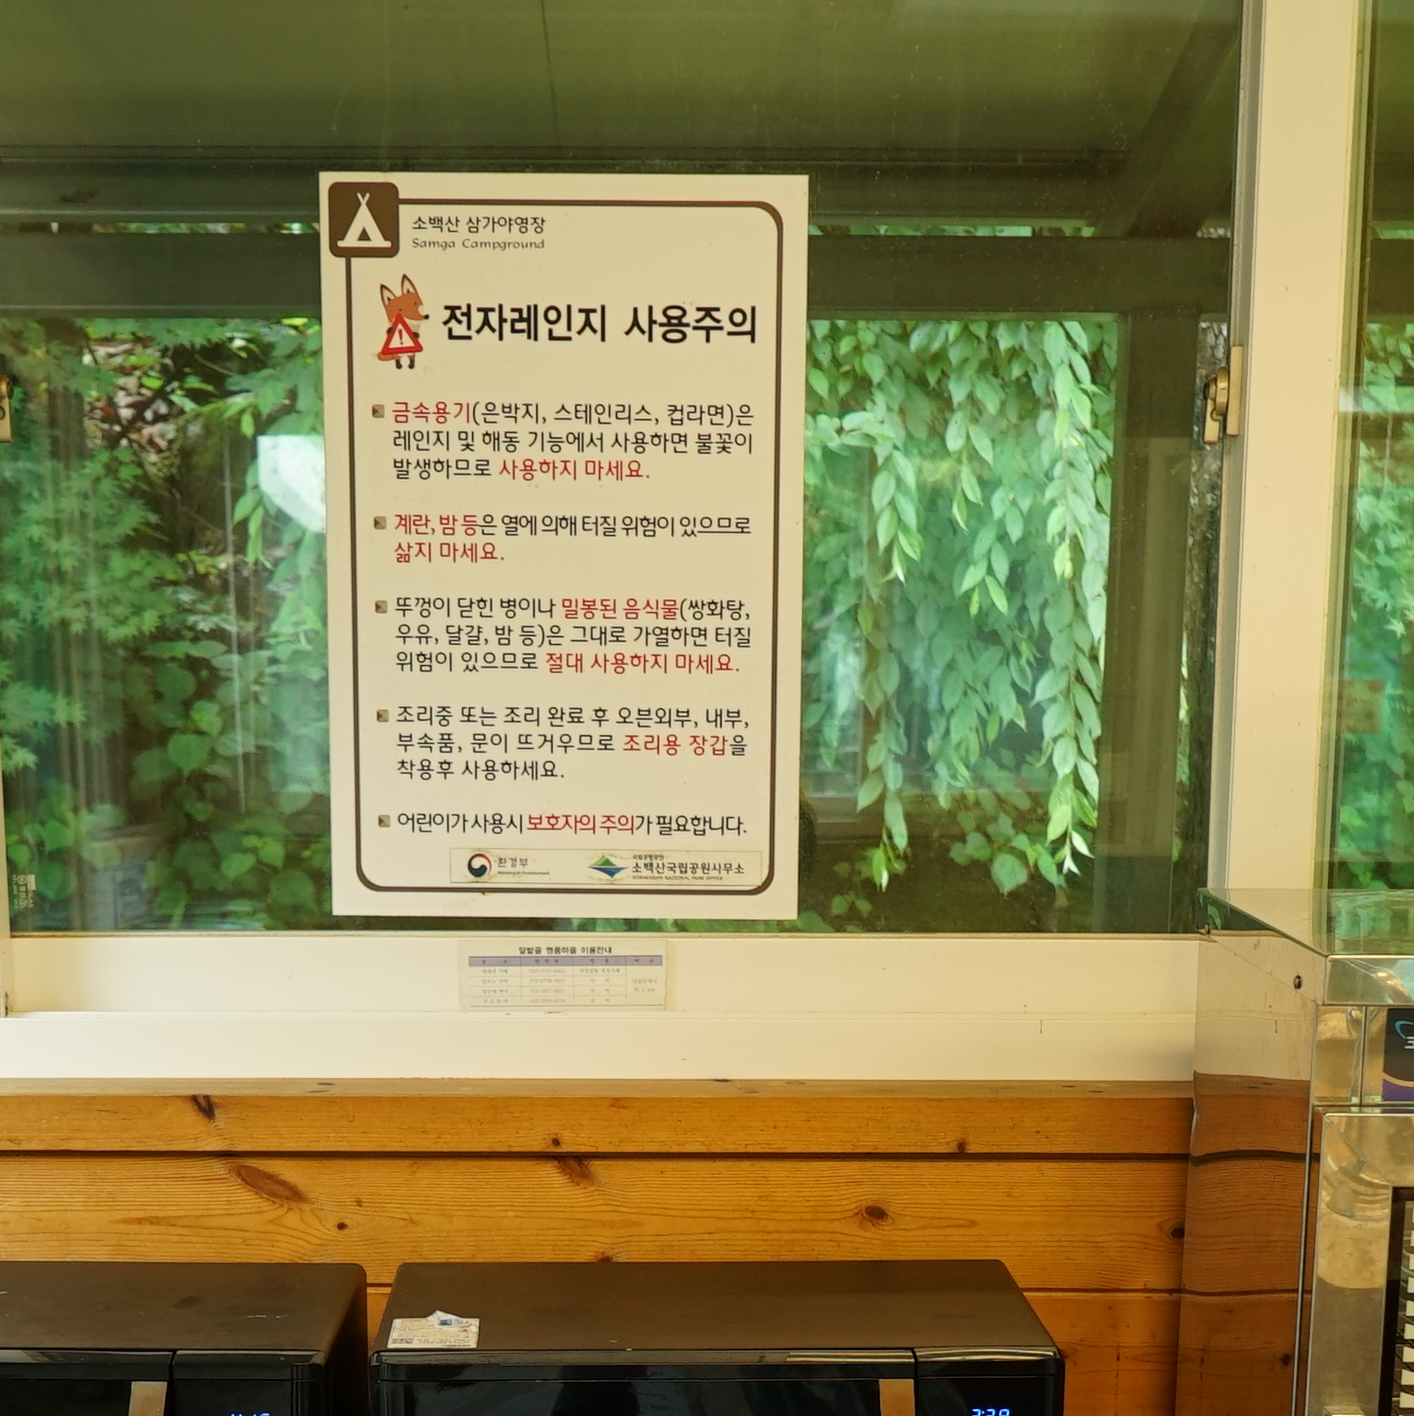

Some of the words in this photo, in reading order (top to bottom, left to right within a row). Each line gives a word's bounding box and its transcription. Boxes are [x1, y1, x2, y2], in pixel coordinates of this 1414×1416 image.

[412, 215, 461, 233] 소백산
[465, 216, 546, 235] 삼가야영장
[412, 237, 456, 251] Samga
[461, 238, 545, 251] Campground
[441, 302, 607, 343] 전자레인지
[623, 304, 757, 345] 사용주의
[391, 401, 547, 426] 금속용기(은박지,
[553, 403, 660, 426] 스테인리스,
[667, 403, 755, 429] 컵라면)은
[393, 429, 450, 452] 레인지
[457, 430, 476, 453] 및
[481, 430, 521, 454] 해동
[528, 431, 604, 454] 기능에서
[610, 431, 689, 455] 사용하면
[694, 432, 753, 455] 불꽃이
[393, 458, 492, 481] 발생하므로
[498, 458, 577, 482] 사용하지
[584, 459, 650, 482] 마세요.
[394, 514, 436, 536] 계란,
[439, 514, 459, 536] 밤
[460, 513, 498, 537] 등은
[501, 514, 538, 537] 열에
[540, 514, 578, 537] 의해
[581, 515, 617, 538] 터질
[620, 515, 675, 538] 위험이
[679, 516, 752, 538] 있으므로
[394, 541, 432, 564] 삶지
[439, 542, 505, 564] 마세요.
[394, 596, 451, 619] 뚜껑이
[457, 596, 494, 619] 닫힌
[499, 597, 557, 620] 병이나
[561, 598, 617, 620] 밀봉된
[622, 597, 750, 623] 음식물(쌍화탕,
[395, 623, 439, 646] 우유,
[445, 624, 489, 646] 달걀,
[494, 624, 514, 647] 밤
[518, 623, 565, 648] 등)은
[569, 625, 627, 647] 그대로
[633, 625, 708, 648] 가열하면
[714, 626, 751, 649] 터질
[395, 650, 453, 673] 위험이
[460, 651, 539, 673] 있으므로
[545, 652, 584, 674] 절대
[590, 652, 668, 675] 사용하지
[675, 653, 740, 675] 마세요.
[396, 705, 454, 728] 조리중
[459, 706, 498, 727] 또는
[503, 706, 540, 728] 조리
[547, 706, 585, 728] 완료
[590, 706, 610, 728] 후
[615, 706, 699, 729] 오븐외부,
[705, 708, 749, 730] 내부,
[396, 732, 463, 754] 부속품,
[469, 732, 508, 754] 문이
[516, 733, 615, 755] 뜨거우므로
[622, 733, 682, 757] 조리용
[688, 734, 748, 757] 장갑을
[397, 758, 455, 781] 착용후
[461, 759, 565, 782] 사용하세요.
[397, 812, 469, 834] 어린이가
[470, 812, 523, 835] 사용시
[526, 813, 596, 835] 보호자의
[599, 814, 654, 836] 주의가
[655, 814, 747, 837] 필요합니다.
[497, 857, 529, 868] 환경부
[631, 861, 745, 875] 소백산국립공원사무소
